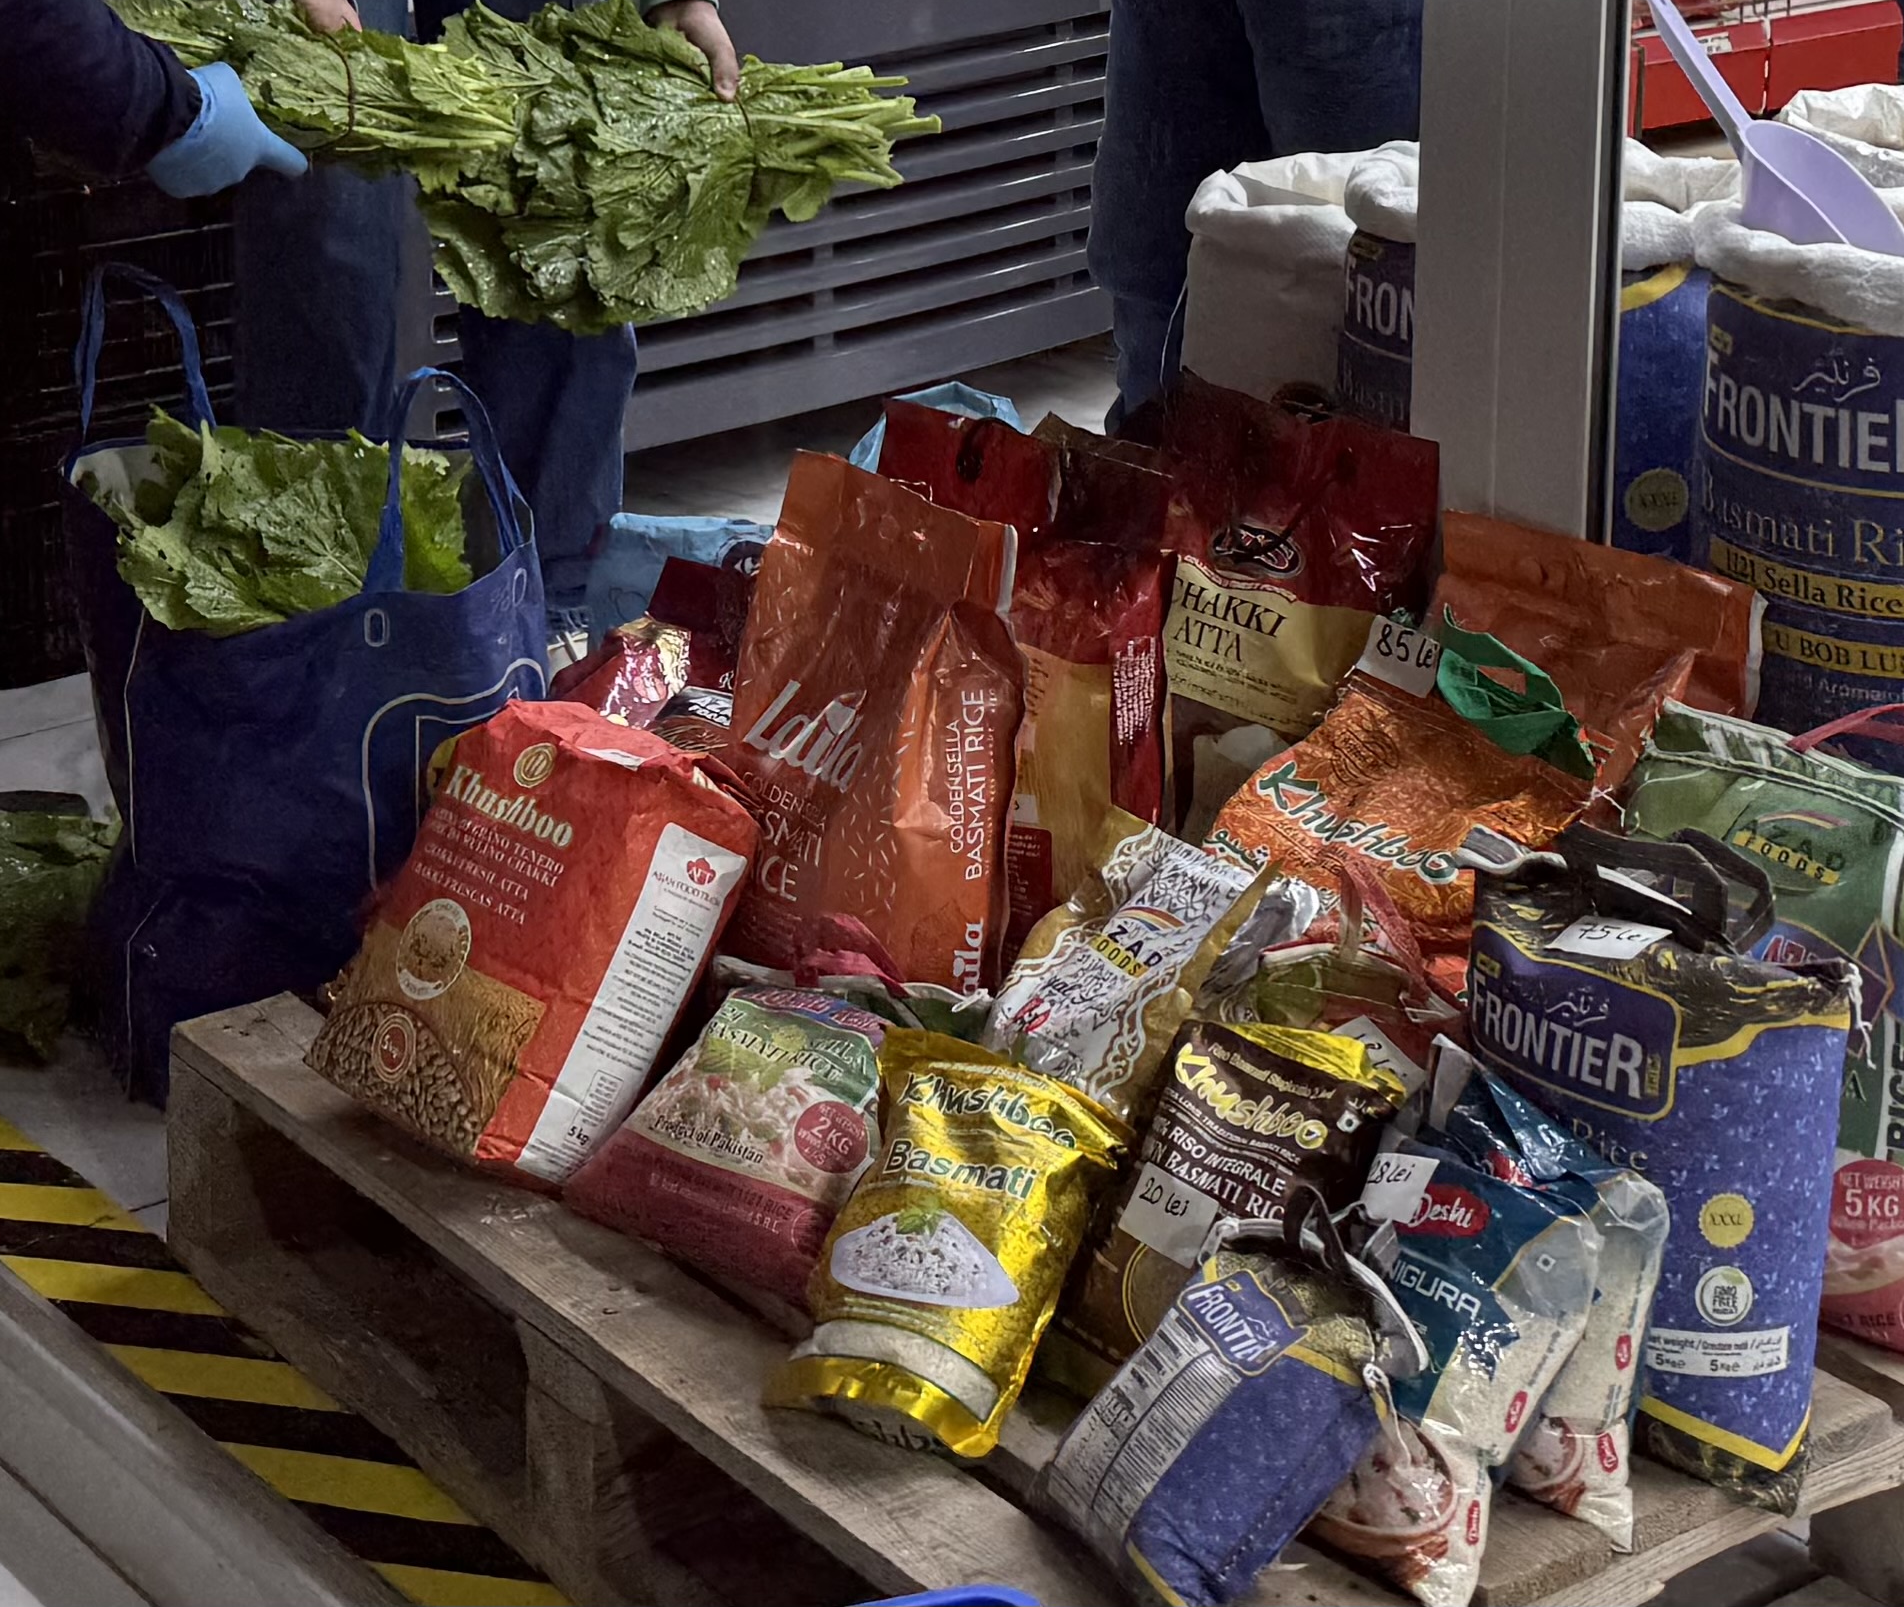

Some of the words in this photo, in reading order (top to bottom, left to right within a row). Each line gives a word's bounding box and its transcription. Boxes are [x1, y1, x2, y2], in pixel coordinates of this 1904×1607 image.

[1764, 568, 1826, 605] Sella
[1836, 584, 1903, 615] Rice
[1173, 616, 1242, 662] ATTA
[1377, 625, 1414, 661] 85
[1800, 638, 1850, 666] BOB
[966, 688, 985, 769] RICE
[445, 765, 573, 849] Khushboo
[964, 777, 984, 881] BASMATI
[1257, 762, 1459, 885] Khushboo
[507, 855, 558, 889] CHAKKI
[514, 842, 564, 875] TENERO
[1742, 836, 1826, 881] FOODS
[499, 878, 529, 901] ATTA
[495, 901, 526, 926] ATTA
[1097, 939, 1142, 976] OODS
[1108, 924, 1163, 969] ZAD
[1472, 968, 1643, 1100] FRONTIER
[899, 1071, 1076, 1148] Khushboo
[1174, 1042, 1328, 1150] Khushboo
[654, 1115, 695, 1140] Product
[696, 1125, 709, 1143] of
[711, 1131, 764, 1164] Pakistan
[810, 1116, 825, 1138] 2
[828, 1132, 853, 1156] KG
[884, 1138, 1039, 1199] Basmati
[1169, 1125, 1207, 1160] RISO
[1204, 1151, 1287, 1198] INTEGRALE
[1139, 1177, 1164, 1205] 20
[1166, 1192, 1191, 1218] lei
[1166, 1151, 1244, 1205] BASMATI
[1246, 1192, 1286, 1221] RIC
[1845, 1189, 1863, 1217] 5
[1867, 1194, 1900, 1218] KG
[1406, 1192, 1473, 1229] Deshi
